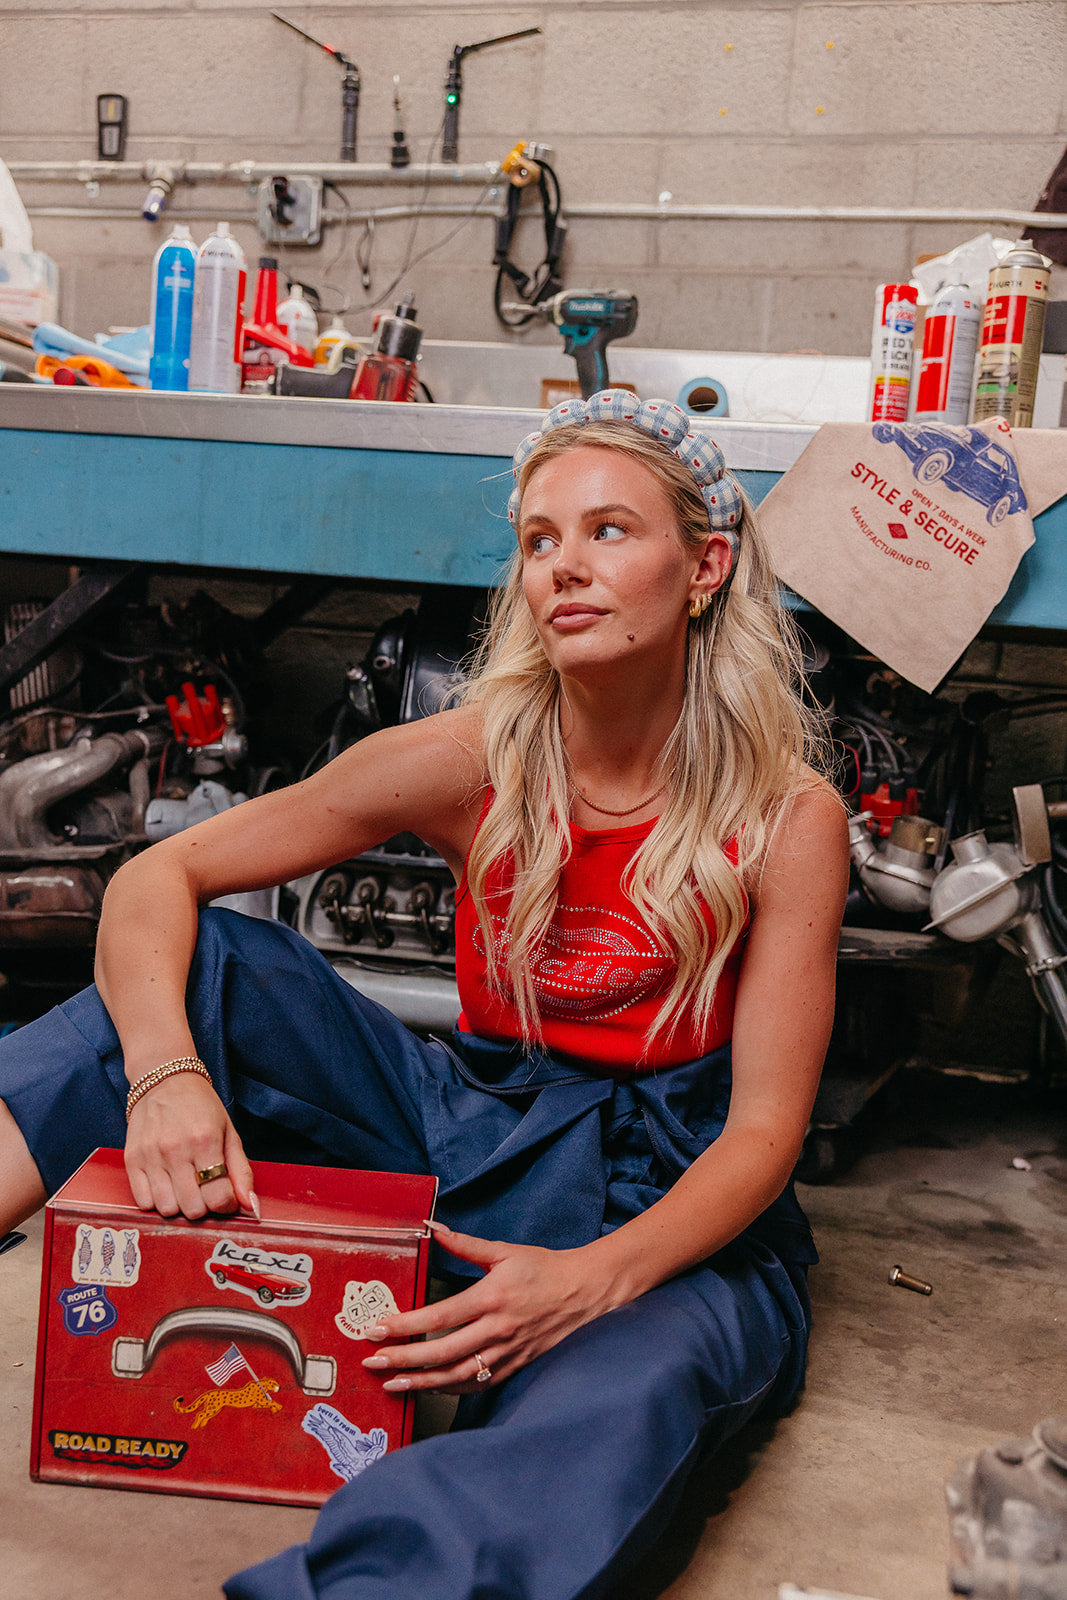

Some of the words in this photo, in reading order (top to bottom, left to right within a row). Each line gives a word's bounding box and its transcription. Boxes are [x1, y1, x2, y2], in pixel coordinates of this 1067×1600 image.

[850, 461, 902, 506] STYLE
[898, 499, 914, 517] &
[914, 511, 980, 566] SECURE
[911, 488, 933, 508] OPEN
[931, 504, 940, 512] 7
[938, 509, 960, 528] DAYS
[957, 524, 965, 532] A
[965, 528, 988, 547] WEEK
[850, 505, 914, 566] MANUFACTURING
[66, 1287, 98, 1304] ROUTE
[72, 1300, 107, 1329] 76
[351, 1307, 359, 1317] 7
[54, 1432, 112, 1453] ROAD
[115, 1438, 184, 1459] READY
